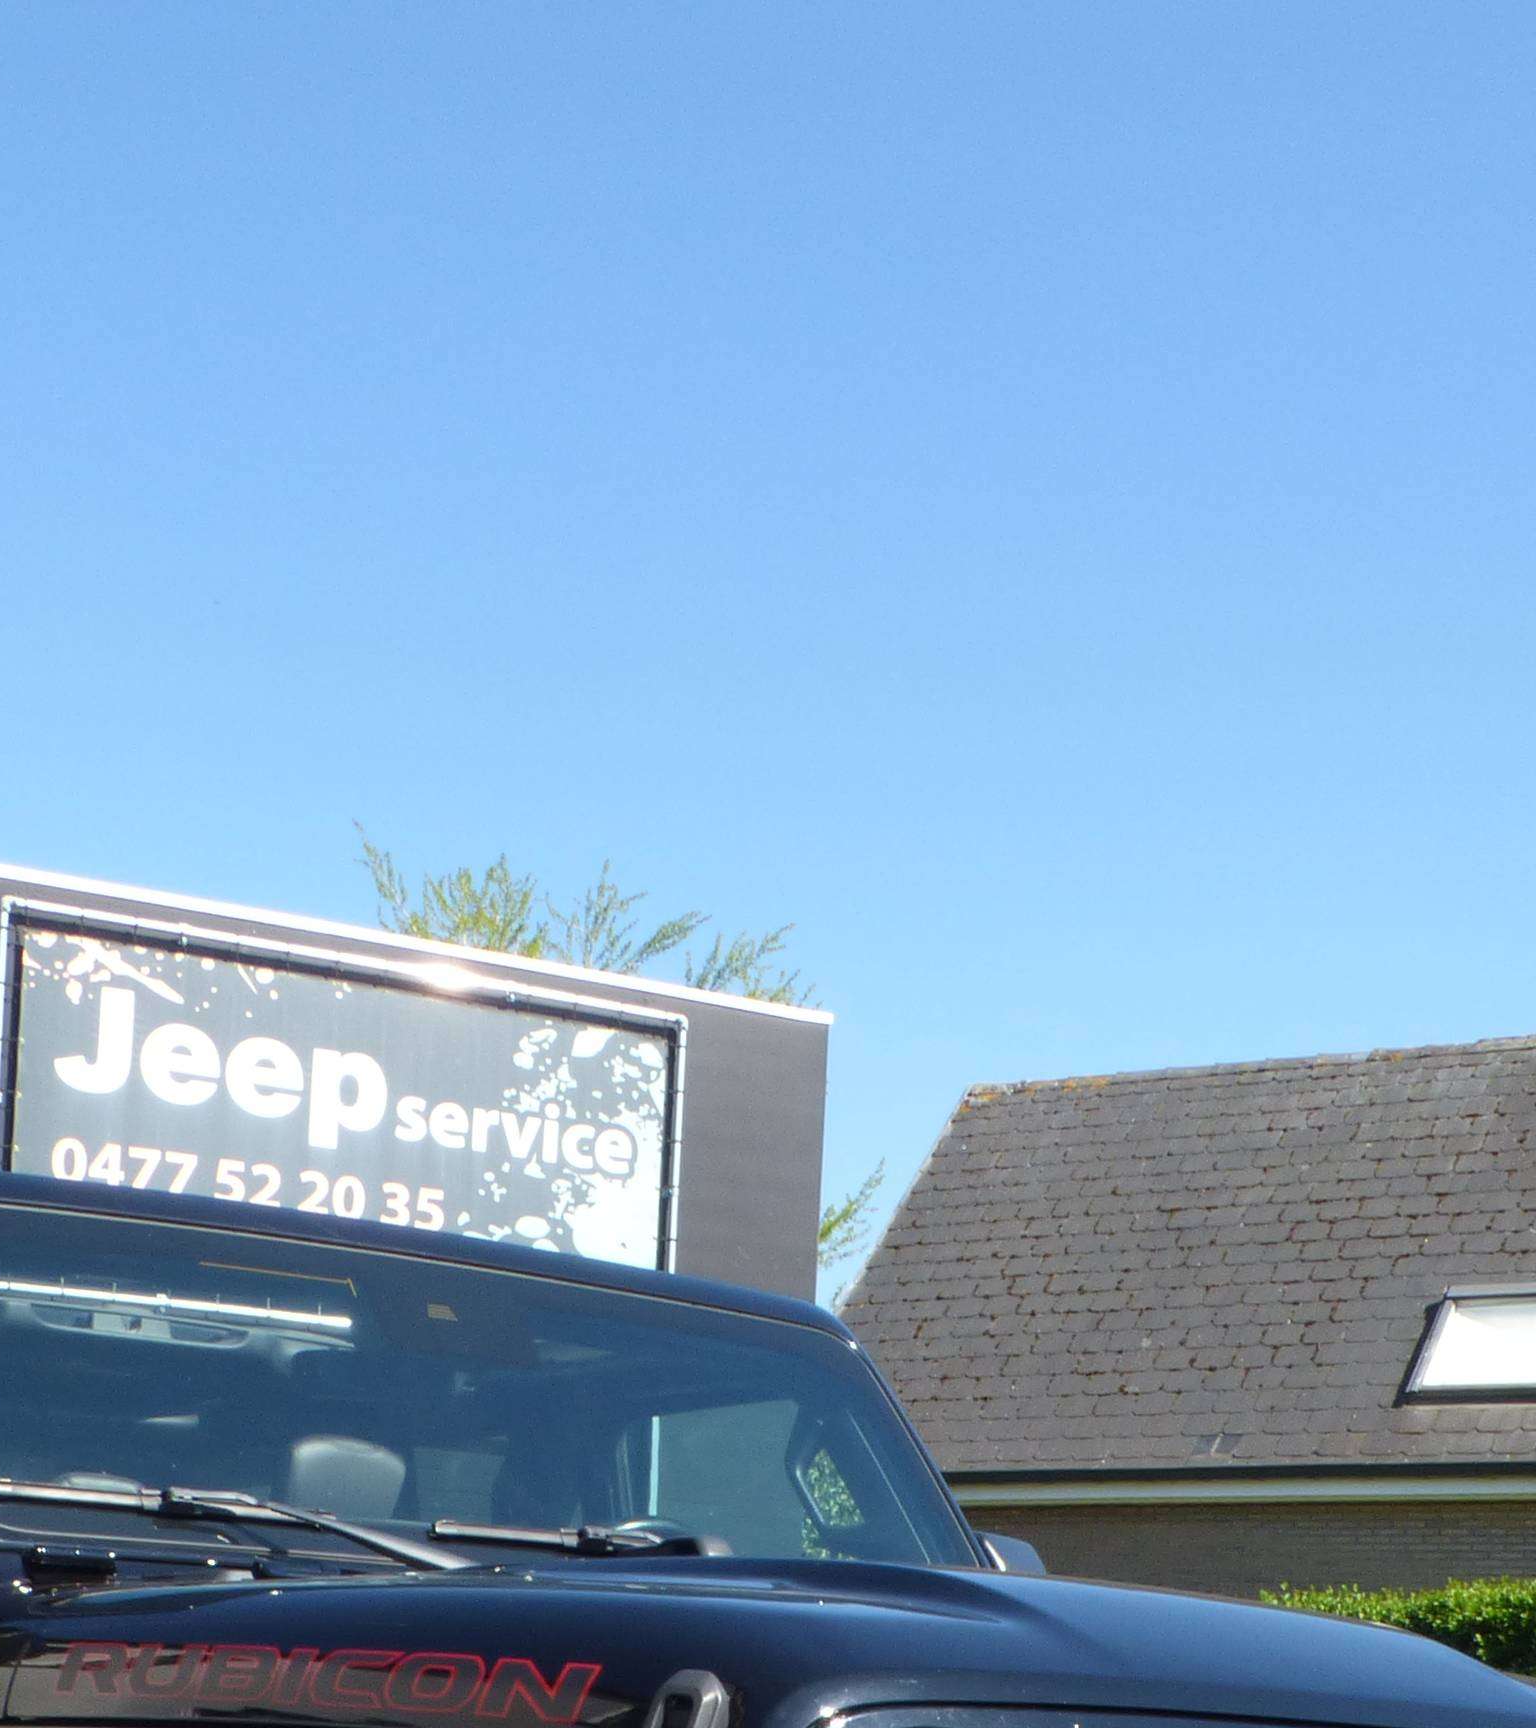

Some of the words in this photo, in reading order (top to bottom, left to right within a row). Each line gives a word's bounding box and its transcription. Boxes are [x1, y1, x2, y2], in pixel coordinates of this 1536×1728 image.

[53, 986, 388, 1150] Jeep
[394, 1095, 634, 1175] service
[51, 1137, 198, 1194] 0477
[214, 1158, 282, 1208] 52
[297, 1170, 367, 1220] 20
[379, 1181, 446, 1232] 35
[57, 1640, 604, 1724] RUBICON
